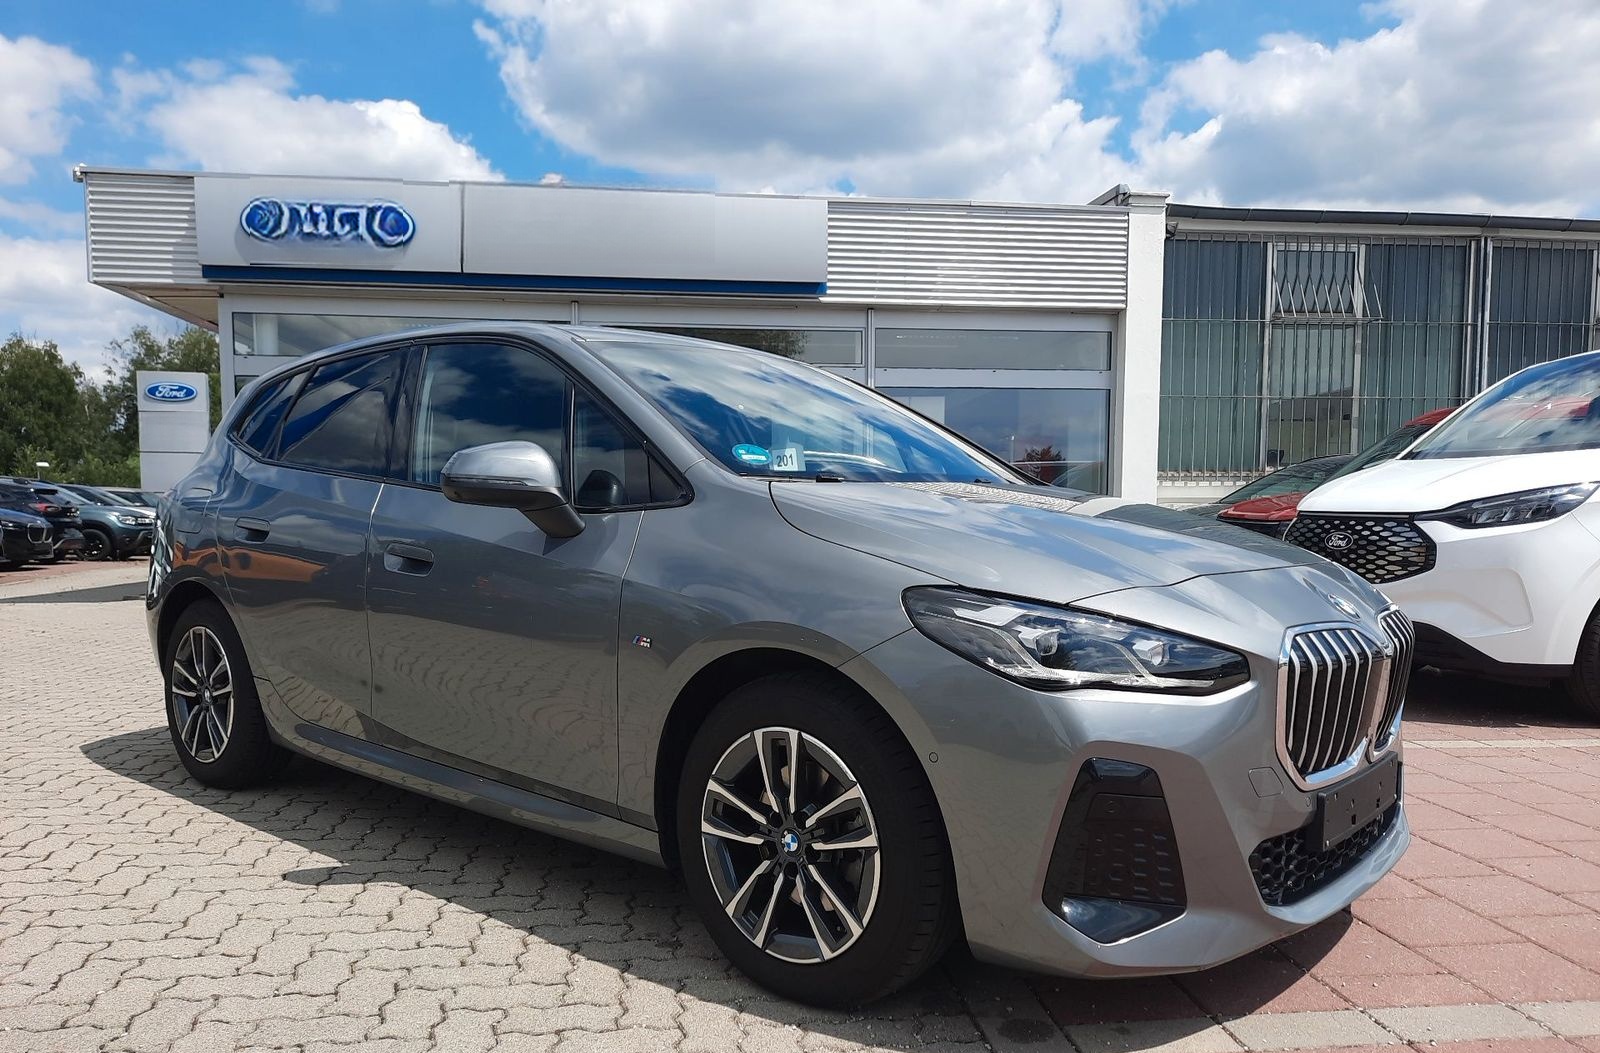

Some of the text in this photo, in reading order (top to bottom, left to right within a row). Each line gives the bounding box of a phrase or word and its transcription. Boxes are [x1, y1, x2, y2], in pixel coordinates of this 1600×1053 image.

[155, 384, 187, 398] Ford
[776, 454, 794, 467] 201
[1328, 534, 1349, 547] Ford
